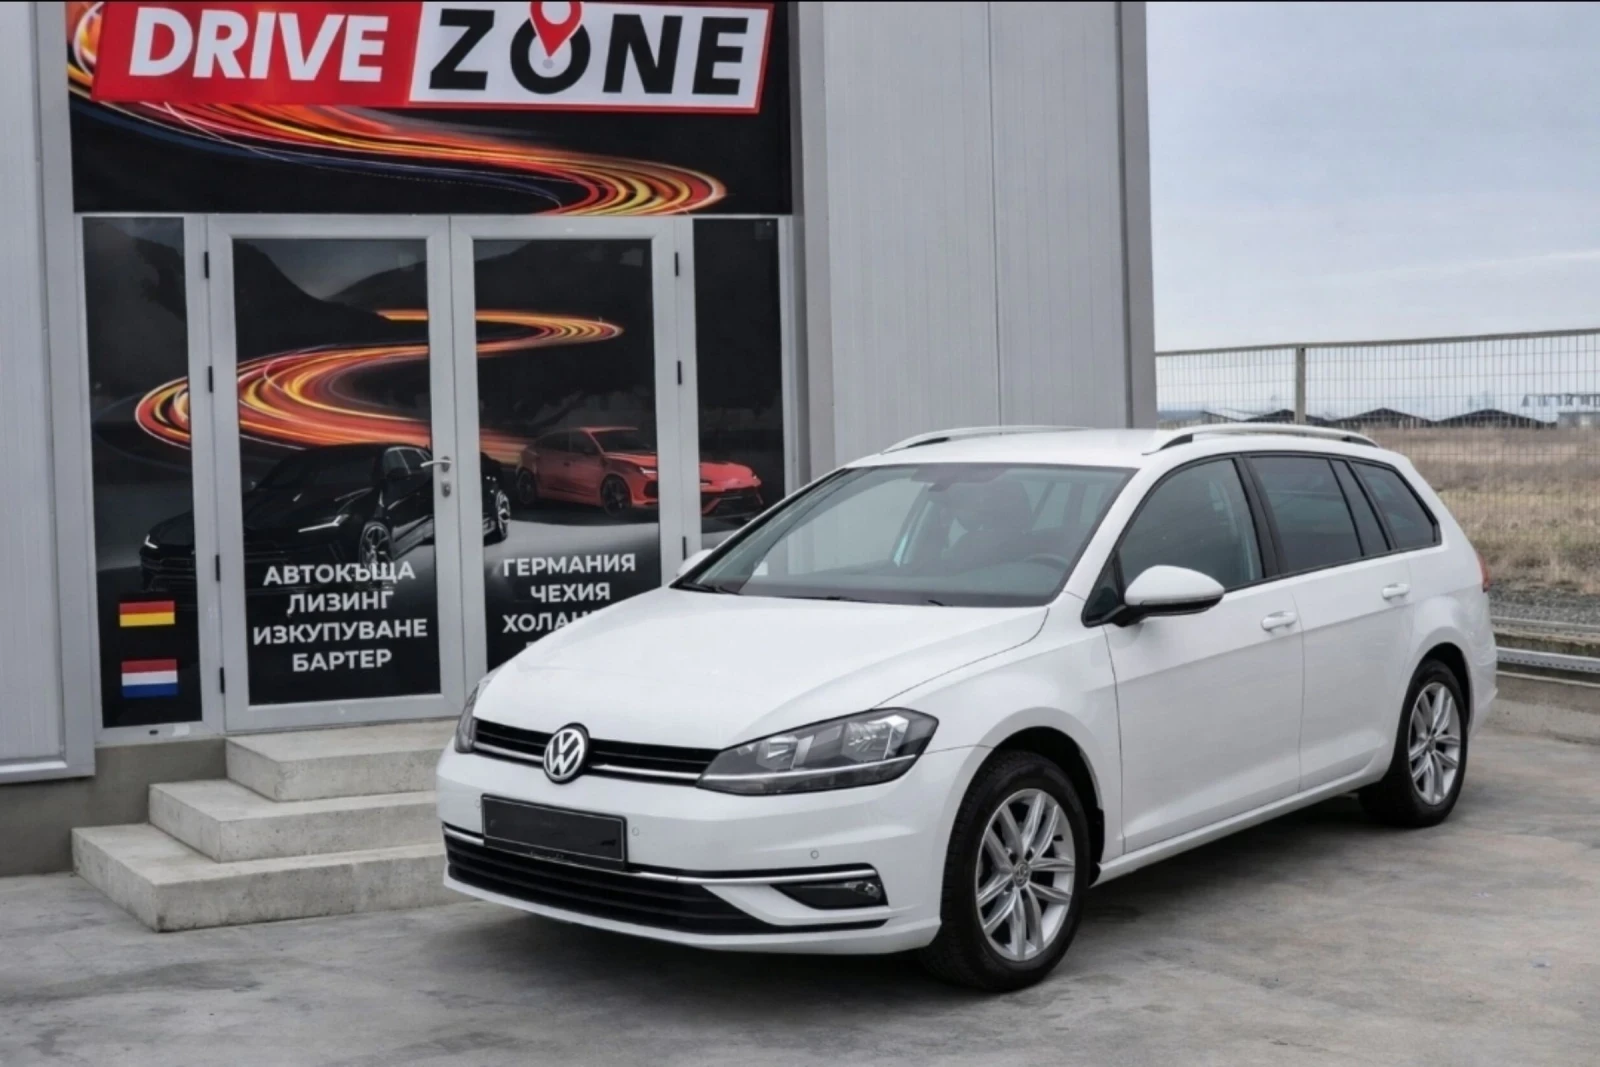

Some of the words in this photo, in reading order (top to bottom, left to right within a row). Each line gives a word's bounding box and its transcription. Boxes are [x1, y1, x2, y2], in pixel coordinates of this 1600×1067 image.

[129, 7, 389, 82] DRIVE
[429, 8, 749, 95] ZONE
[263, 561, 416, 586] АВТОКЪЩА
[503, 553, 636, 577] ГЕРМАНИЯ
[287, 591, 394, 616] ЛИЗИНГ
[530, 582, 610, 603] ЧЕХИЯ
[253, 618, 428, 645] ИЗКУПУВАНЕ
[293, 649, 392, 672] БАРТЕР
